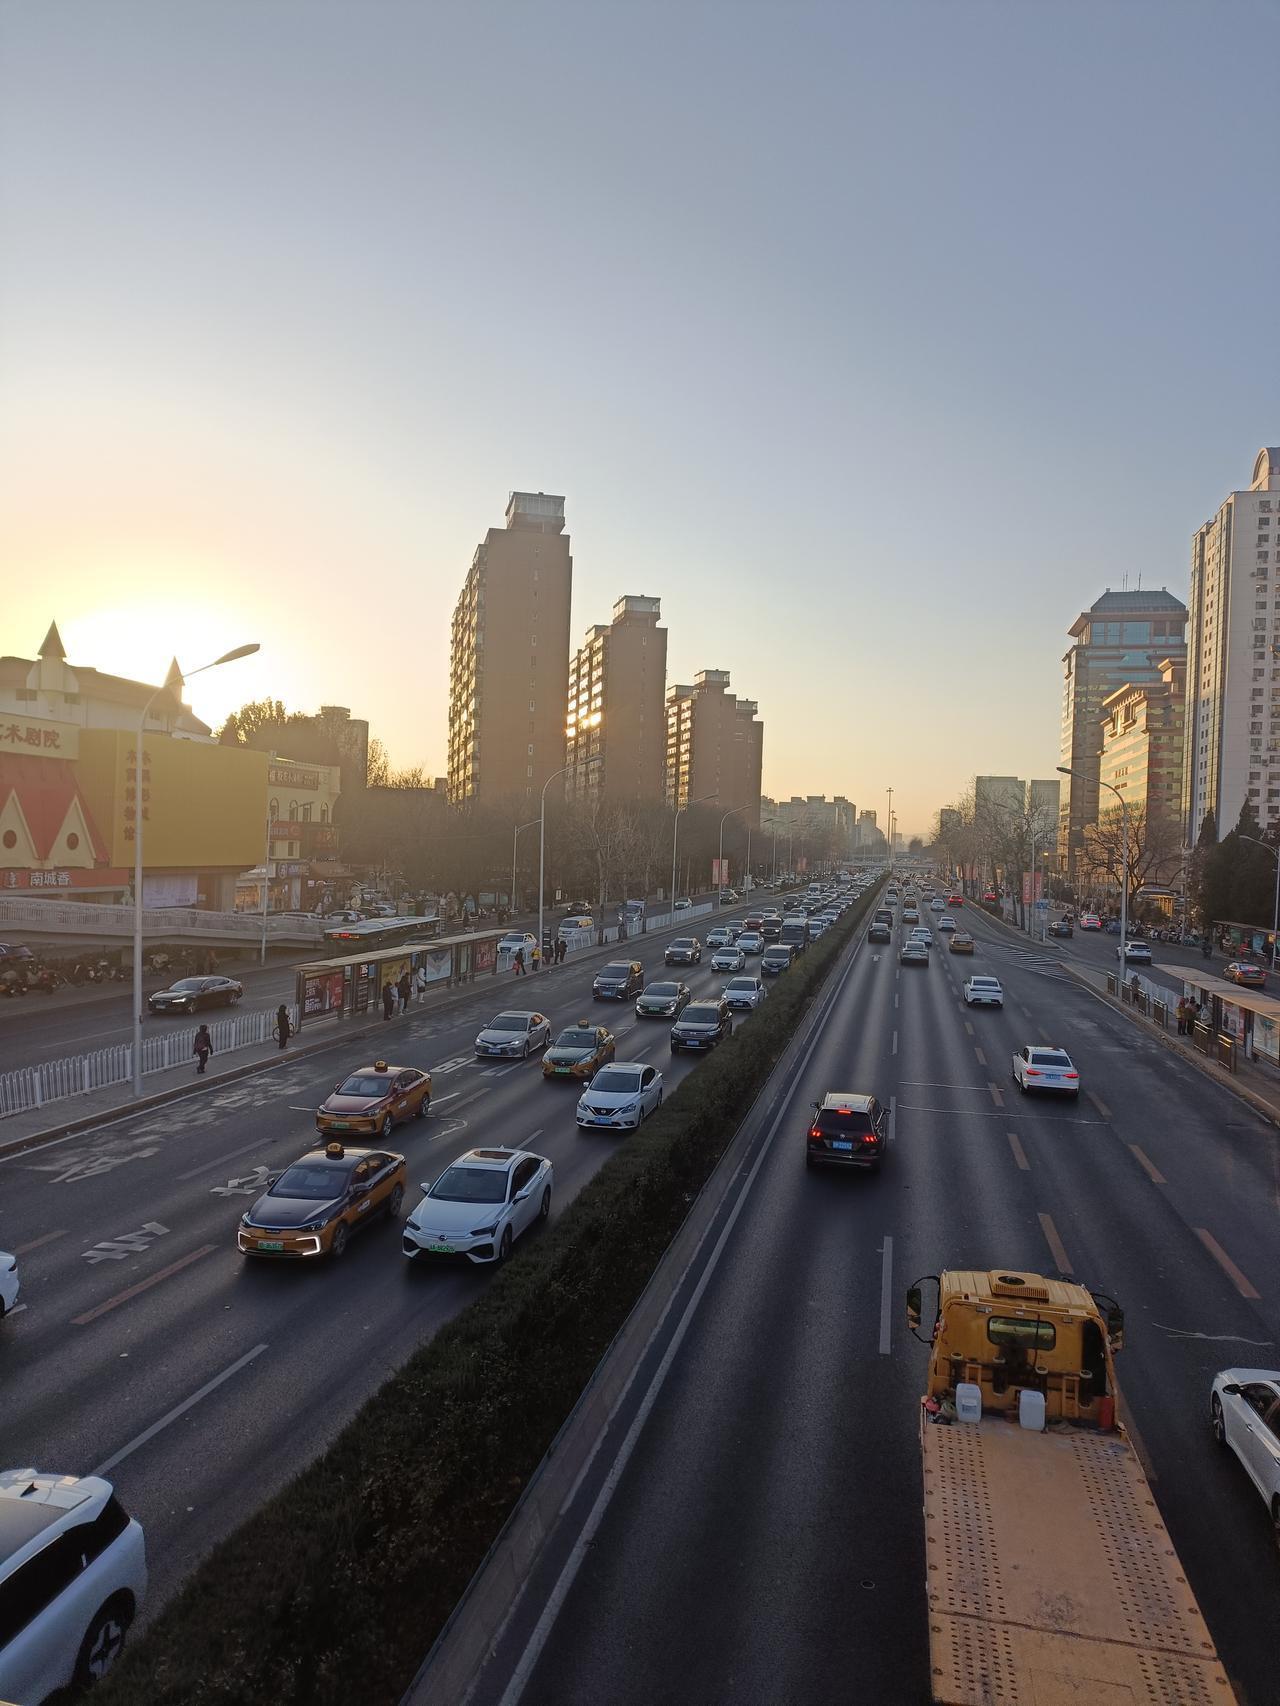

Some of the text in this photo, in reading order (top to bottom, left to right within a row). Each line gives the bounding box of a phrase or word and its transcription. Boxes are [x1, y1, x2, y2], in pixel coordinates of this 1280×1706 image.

[0, 723, 61, 750] 术剧院
[30, 871, 71, 886] 南城香
